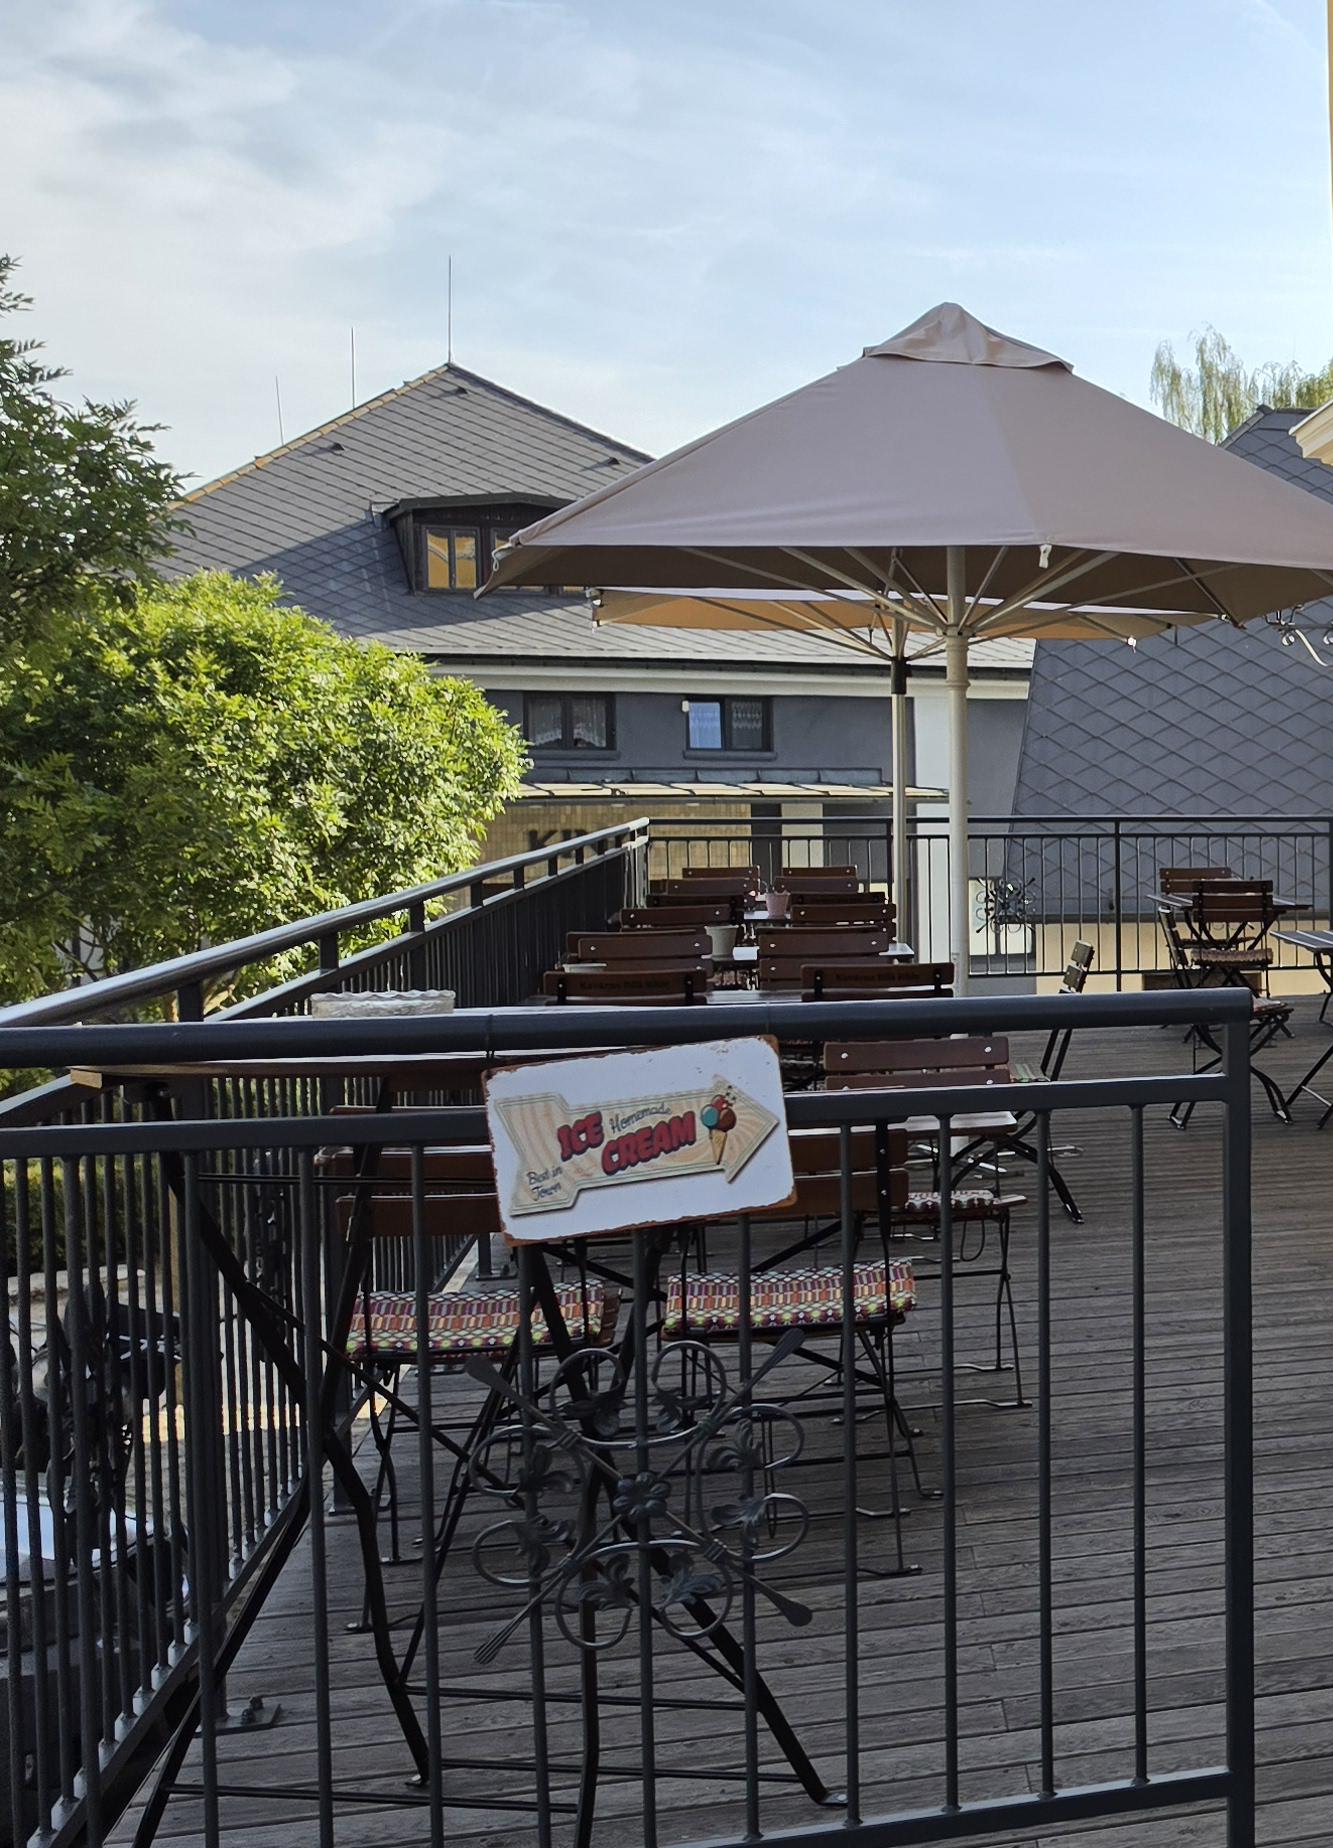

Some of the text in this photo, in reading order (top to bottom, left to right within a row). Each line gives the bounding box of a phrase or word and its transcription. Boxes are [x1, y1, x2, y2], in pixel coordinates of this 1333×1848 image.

[609, 1102, 672, 1133] Homemade
[557, 1110, 697, 1176] ICE CREAM
